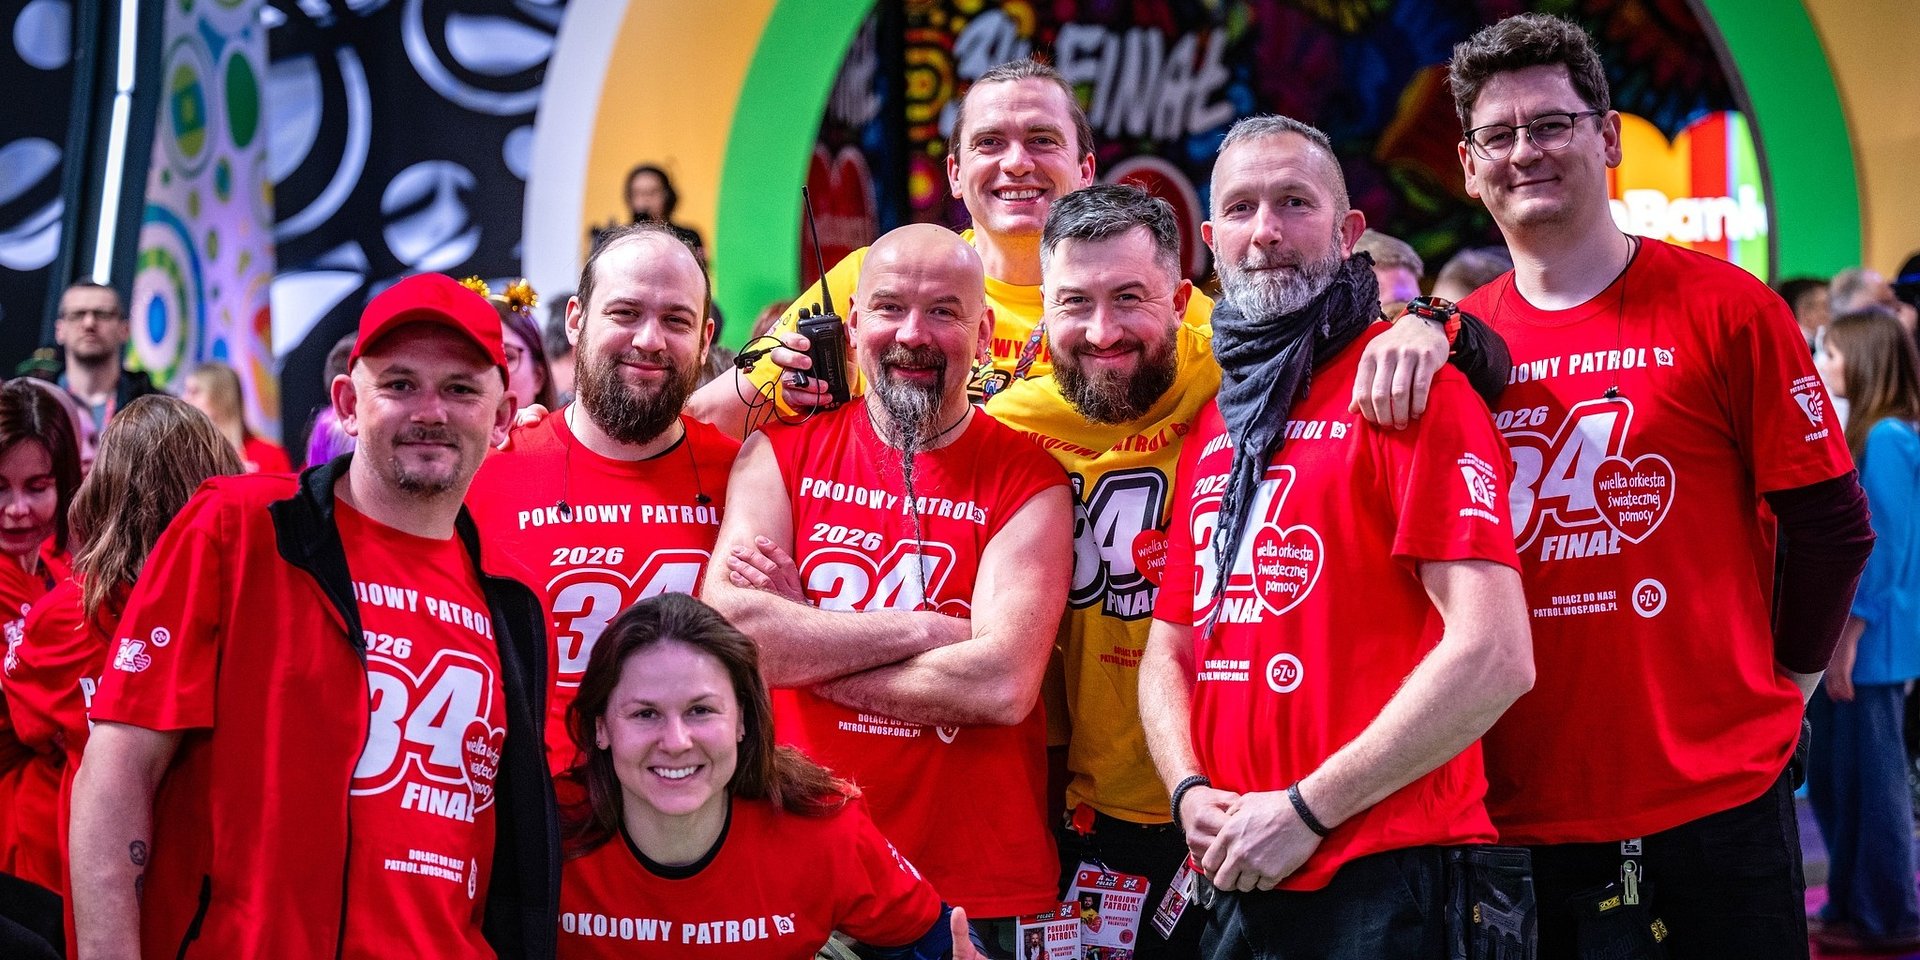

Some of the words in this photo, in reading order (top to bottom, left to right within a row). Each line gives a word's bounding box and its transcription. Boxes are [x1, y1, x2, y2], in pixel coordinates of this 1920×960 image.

[1507, 355, 1562, 386] JOWY
[1569, 347, 1647, 375] PATROL
[1284, 420, 1327, 440] TROL
[1191, 473, 1230, 500] 202
[1599, 472, 1628, 490] wielka
[1629, 472, 1665, 489] orkiestra
[903, 495, 975, 521] PATROL
[1608, 490, 1660, 510] świątecznej
[641, 504, 719, 526] PATROL
[1619, 509, 1653, 526] pomocy
[809, 522, 884, 551] 2026
[1540, 530, 1621, 562] FINAŁ
[550, 546, 625, 566] 2026
[1265, 579, 1300, 599] pomocy
[1552, 593, 1581, 605] DOŁĄCZ
[1583, 591, 1595, 602] DO
[1596, 590, 1617, 601] NAS!
[1639, 590, 1658, 607] PZU
[425, 595, 493, 641] PATROL
[1215, 597, 1265, 623] NAŁ
[1533, 602, 1618, 618] PATROL.WOSP.ORG.PL
[363, 630, 413, 659] 026
[1273, 665, 1295, 682] PZU
[1104, 902, 1131, 912] PATROL
[1105, 894, 1141, 904] POKOJOWY
[559, 912, 673, 942] OKOJOWY
[682, 917, 769, 945] PATROL
[1047, 923, 1079, 934] POKOJOWY
[1047, 931, 1072, 942] PATROL
